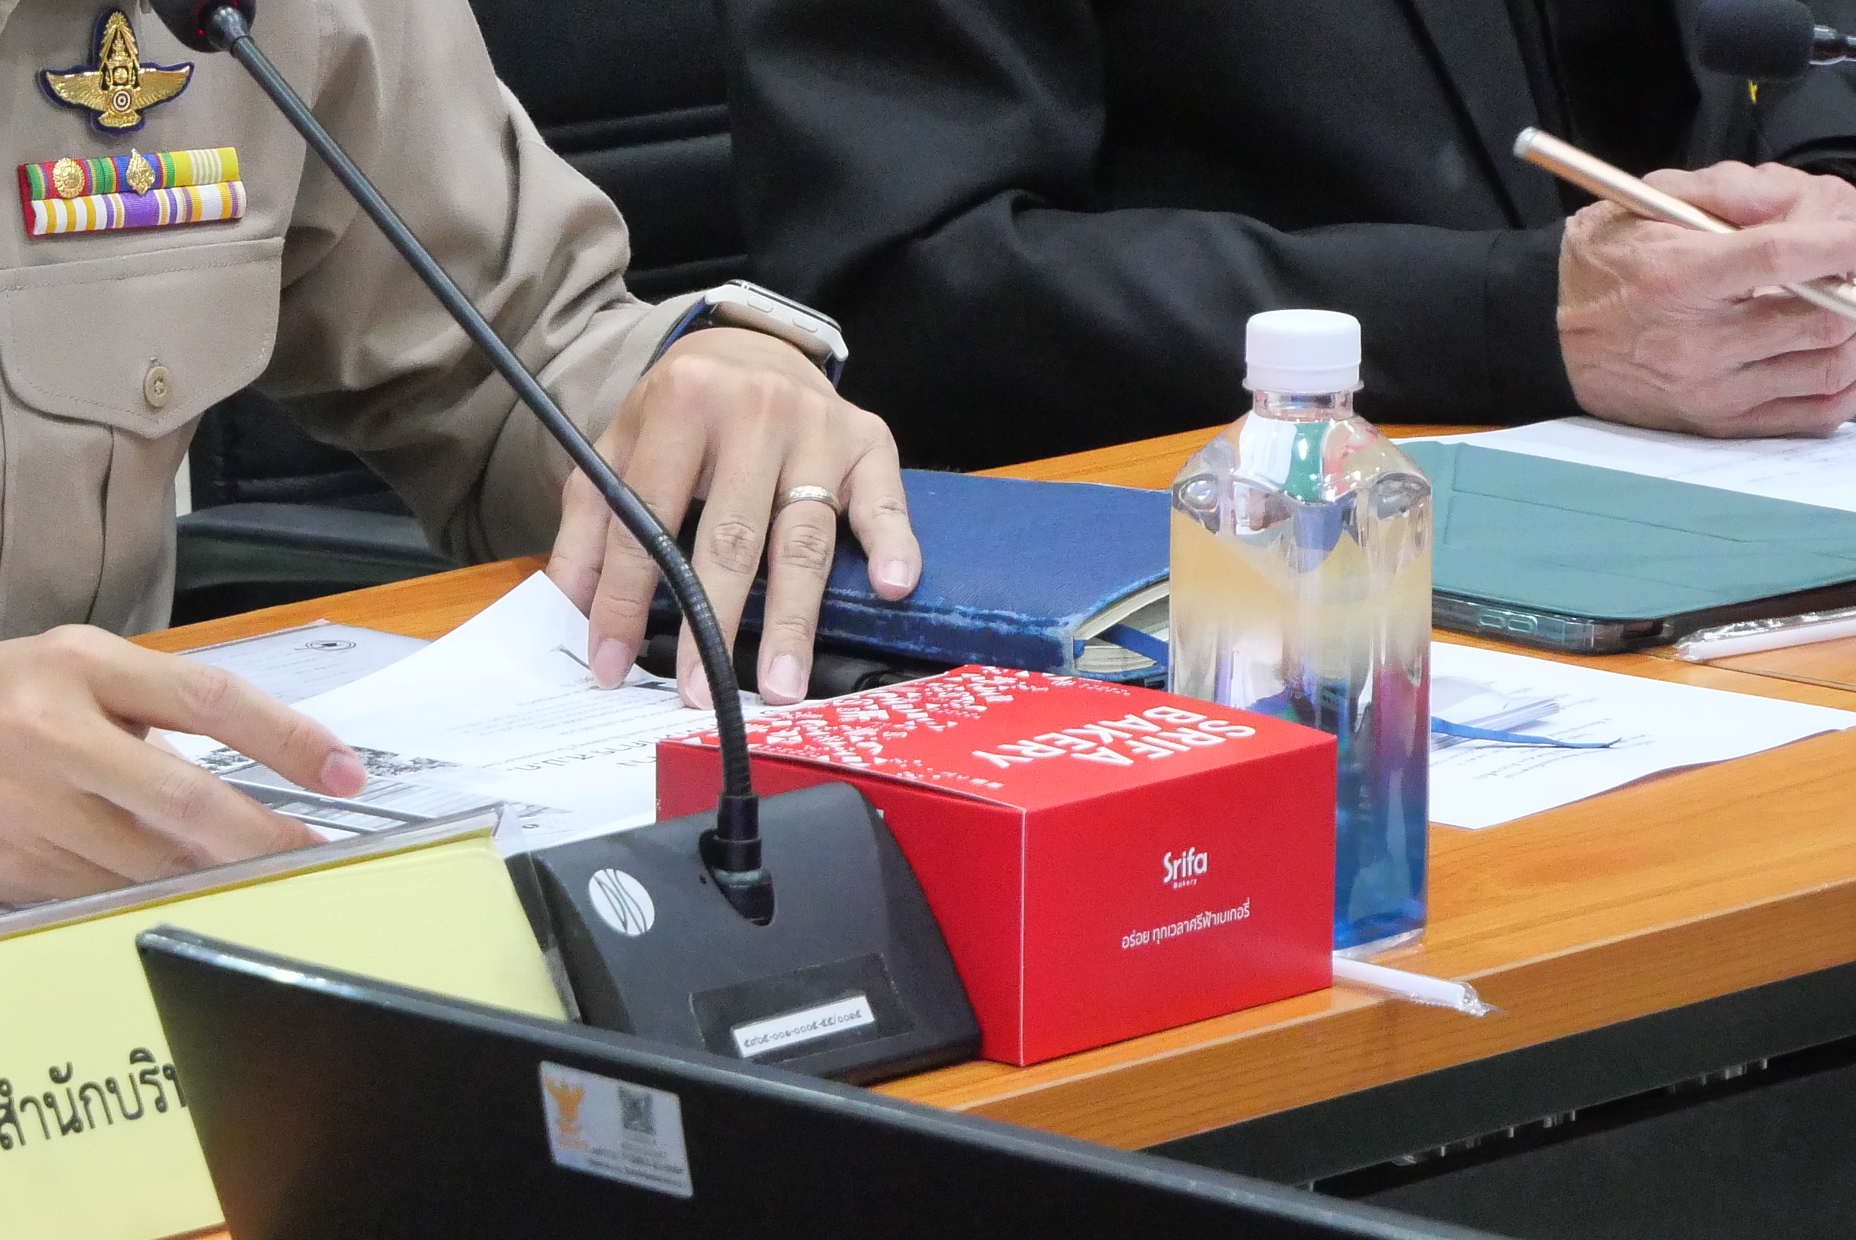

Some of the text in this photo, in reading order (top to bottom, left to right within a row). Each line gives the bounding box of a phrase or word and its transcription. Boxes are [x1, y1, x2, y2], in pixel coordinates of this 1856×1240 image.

[971, 706, 1208, 768] BAKERY
[1070, 719, 1256, 767] SRIFA
[1162, 847, 1208, 883] Srifa
[1121, 897, 1251, 949] อร่อย ทุกเวลาศรีฟ้าเบเกอรี่
